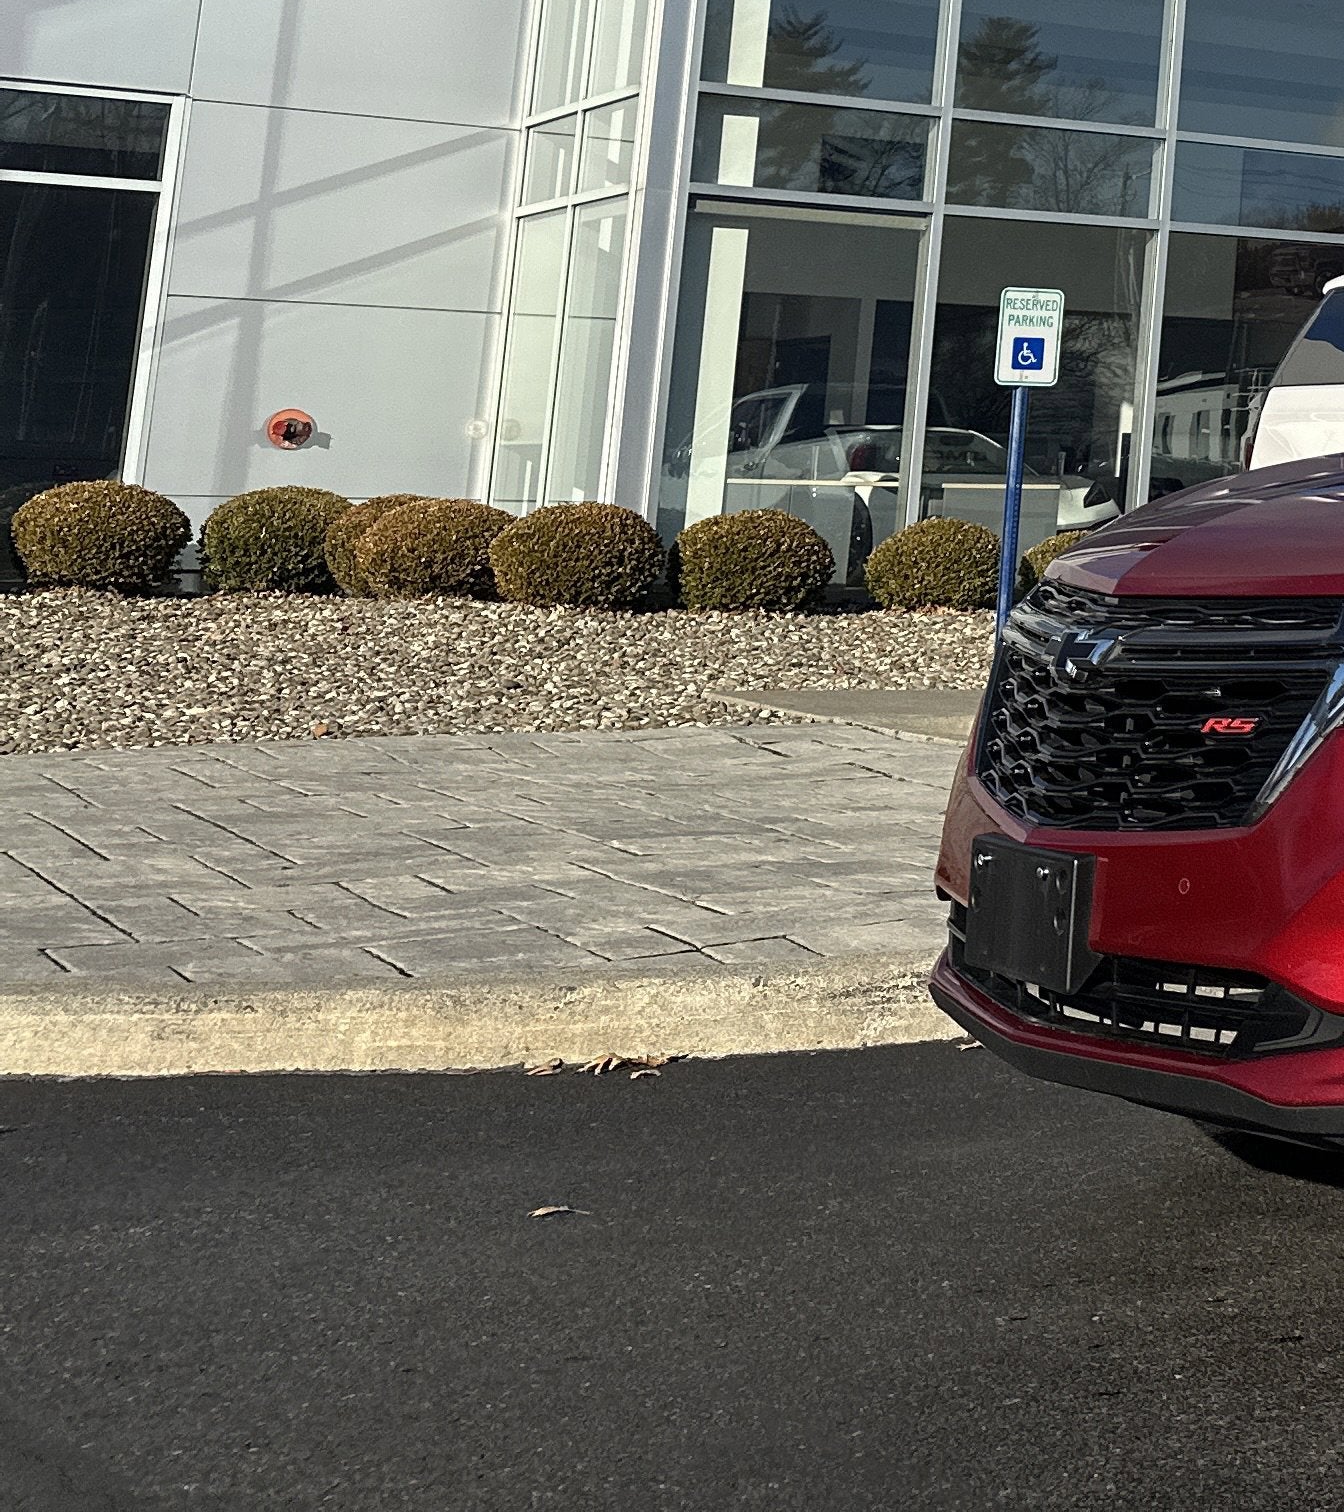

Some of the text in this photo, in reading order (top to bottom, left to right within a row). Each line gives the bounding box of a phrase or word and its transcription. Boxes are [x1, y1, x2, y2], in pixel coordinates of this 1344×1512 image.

[1006, 297, 1059, 312] RESERVED
[1008, 314, 1054, 328] PARKING
[1201, 718, 1259, 733] RS
